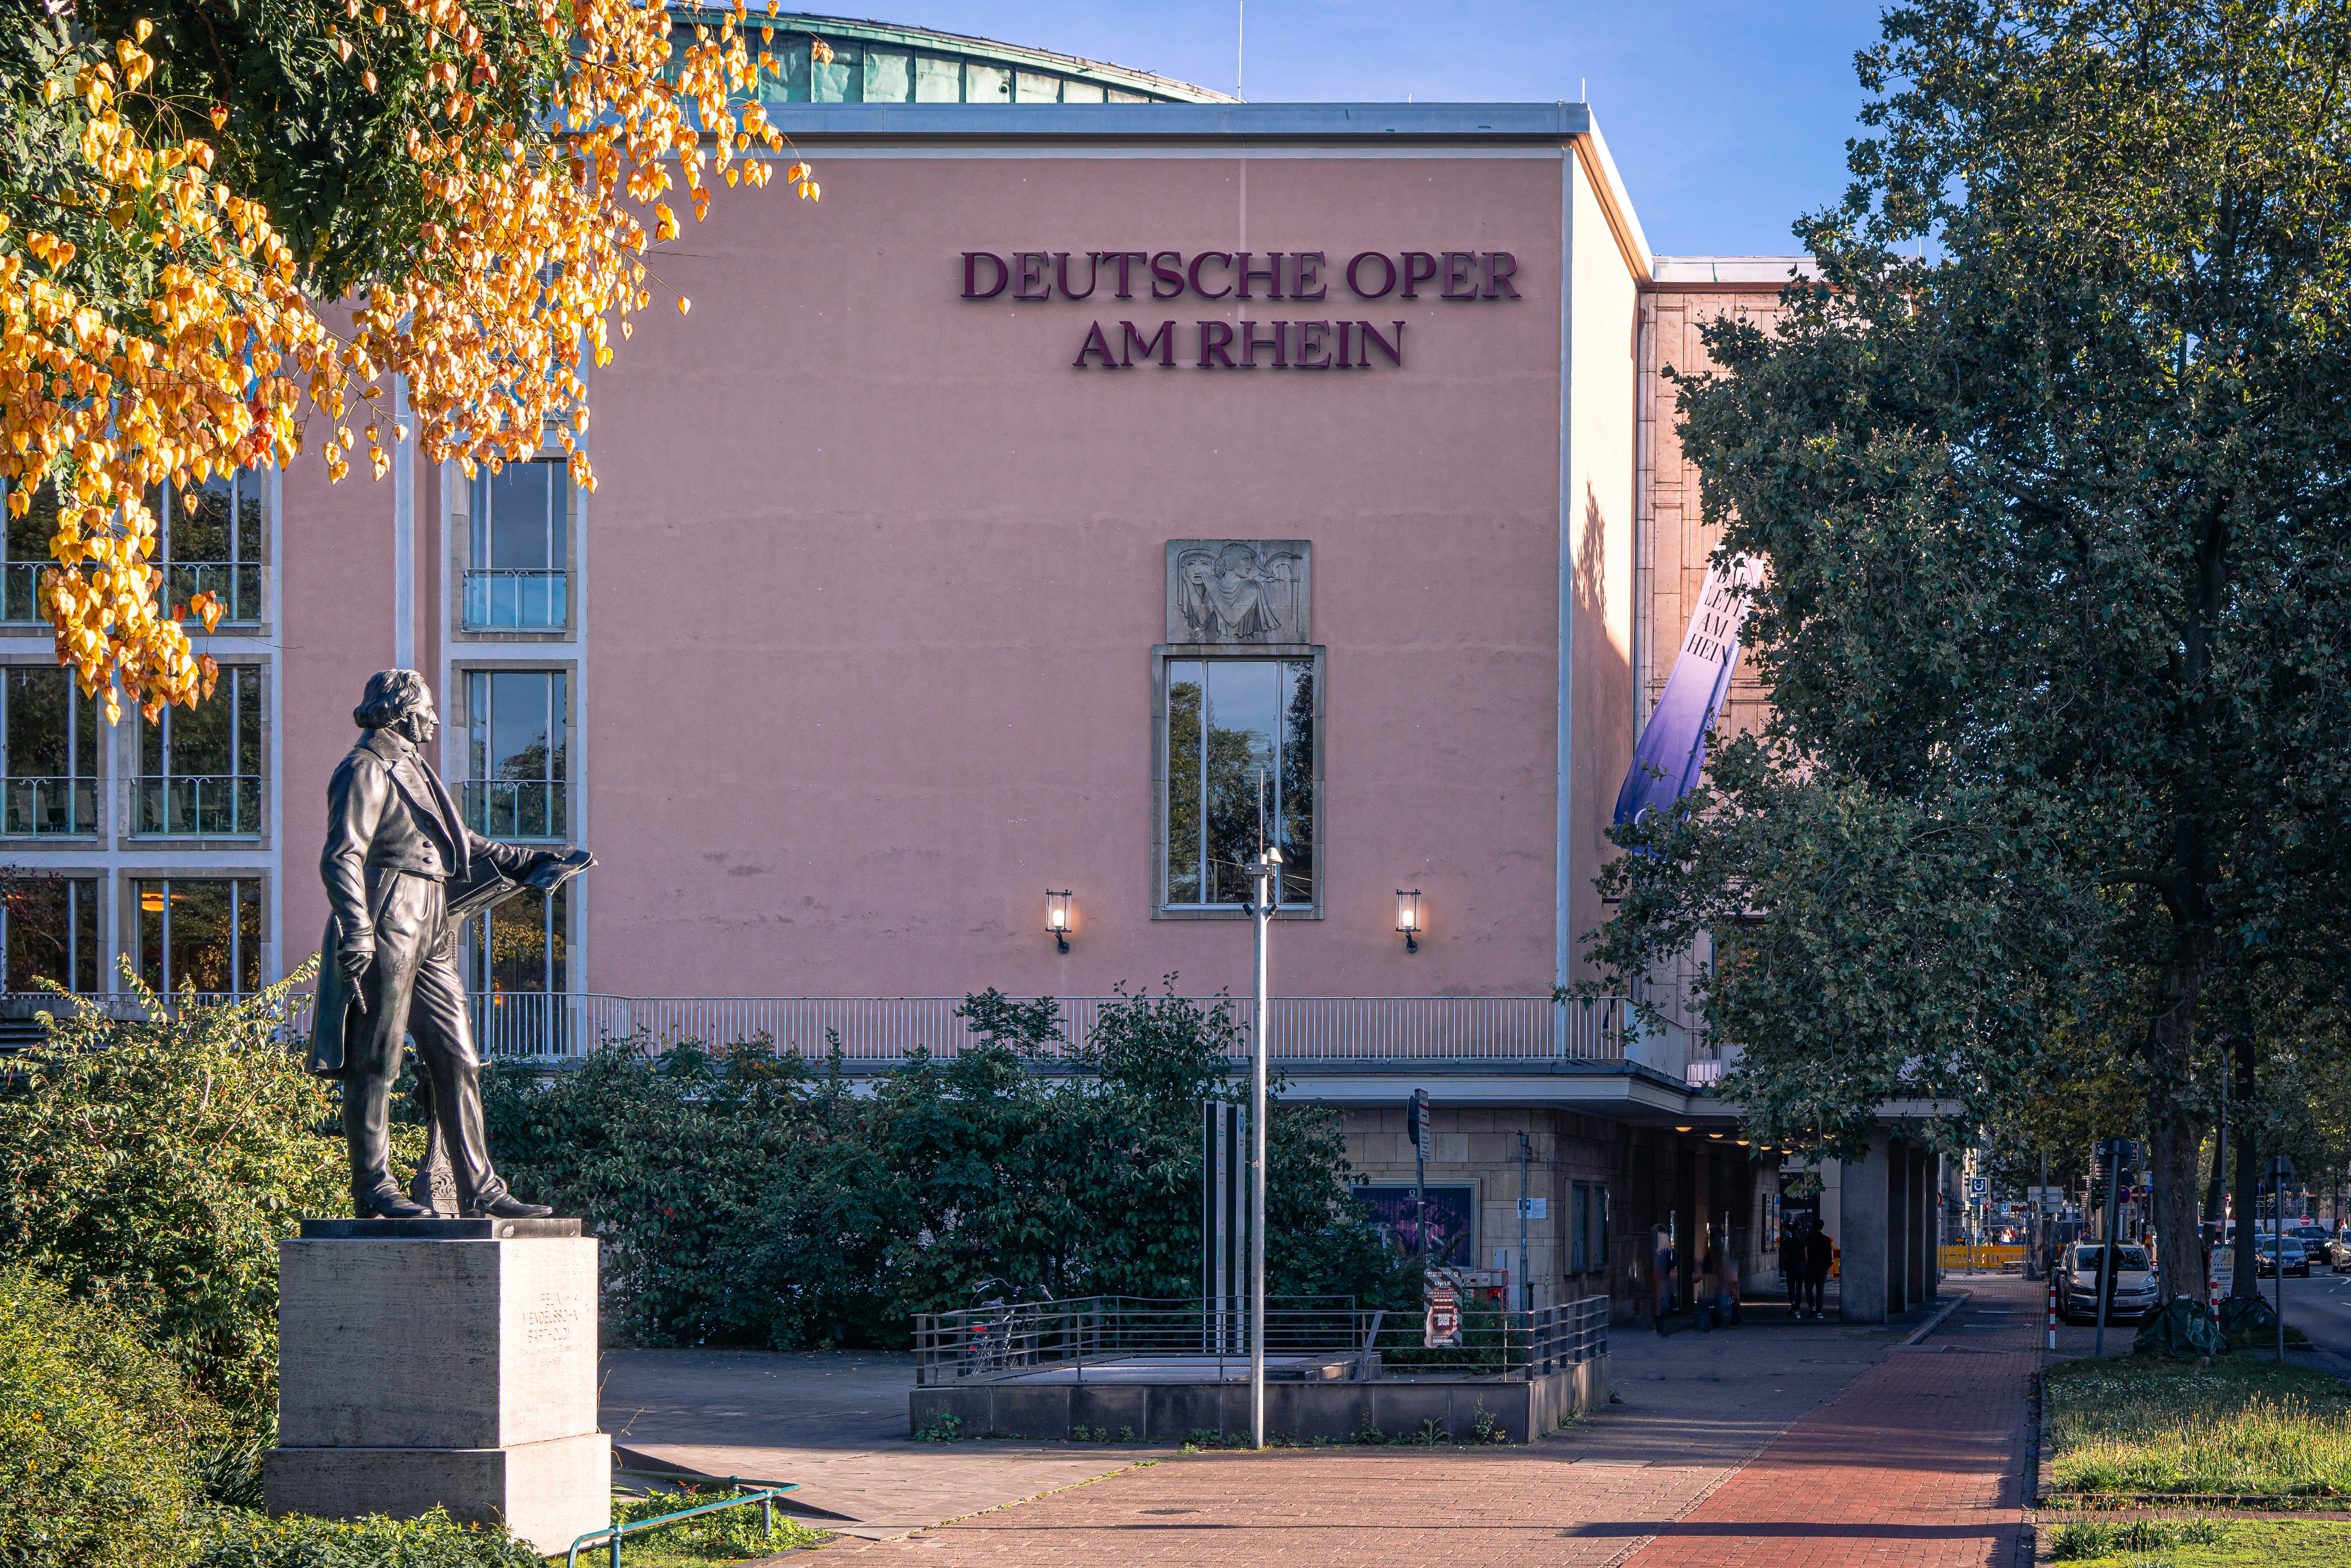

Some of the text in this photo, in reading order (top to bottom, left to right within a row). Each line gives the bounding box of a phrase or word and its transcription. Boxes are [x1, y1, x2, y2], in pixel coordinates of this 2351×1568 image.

[960, 251, 1522, 299] DEUTSCHE OPER
[1071, 320, 1406, 368] AM RHEIN
[1697, 612, 1729, 638] AM
[1685, 633, 1734, 667] HEIN
[522, 1309, 578, 1325] MENDELSSOHN
